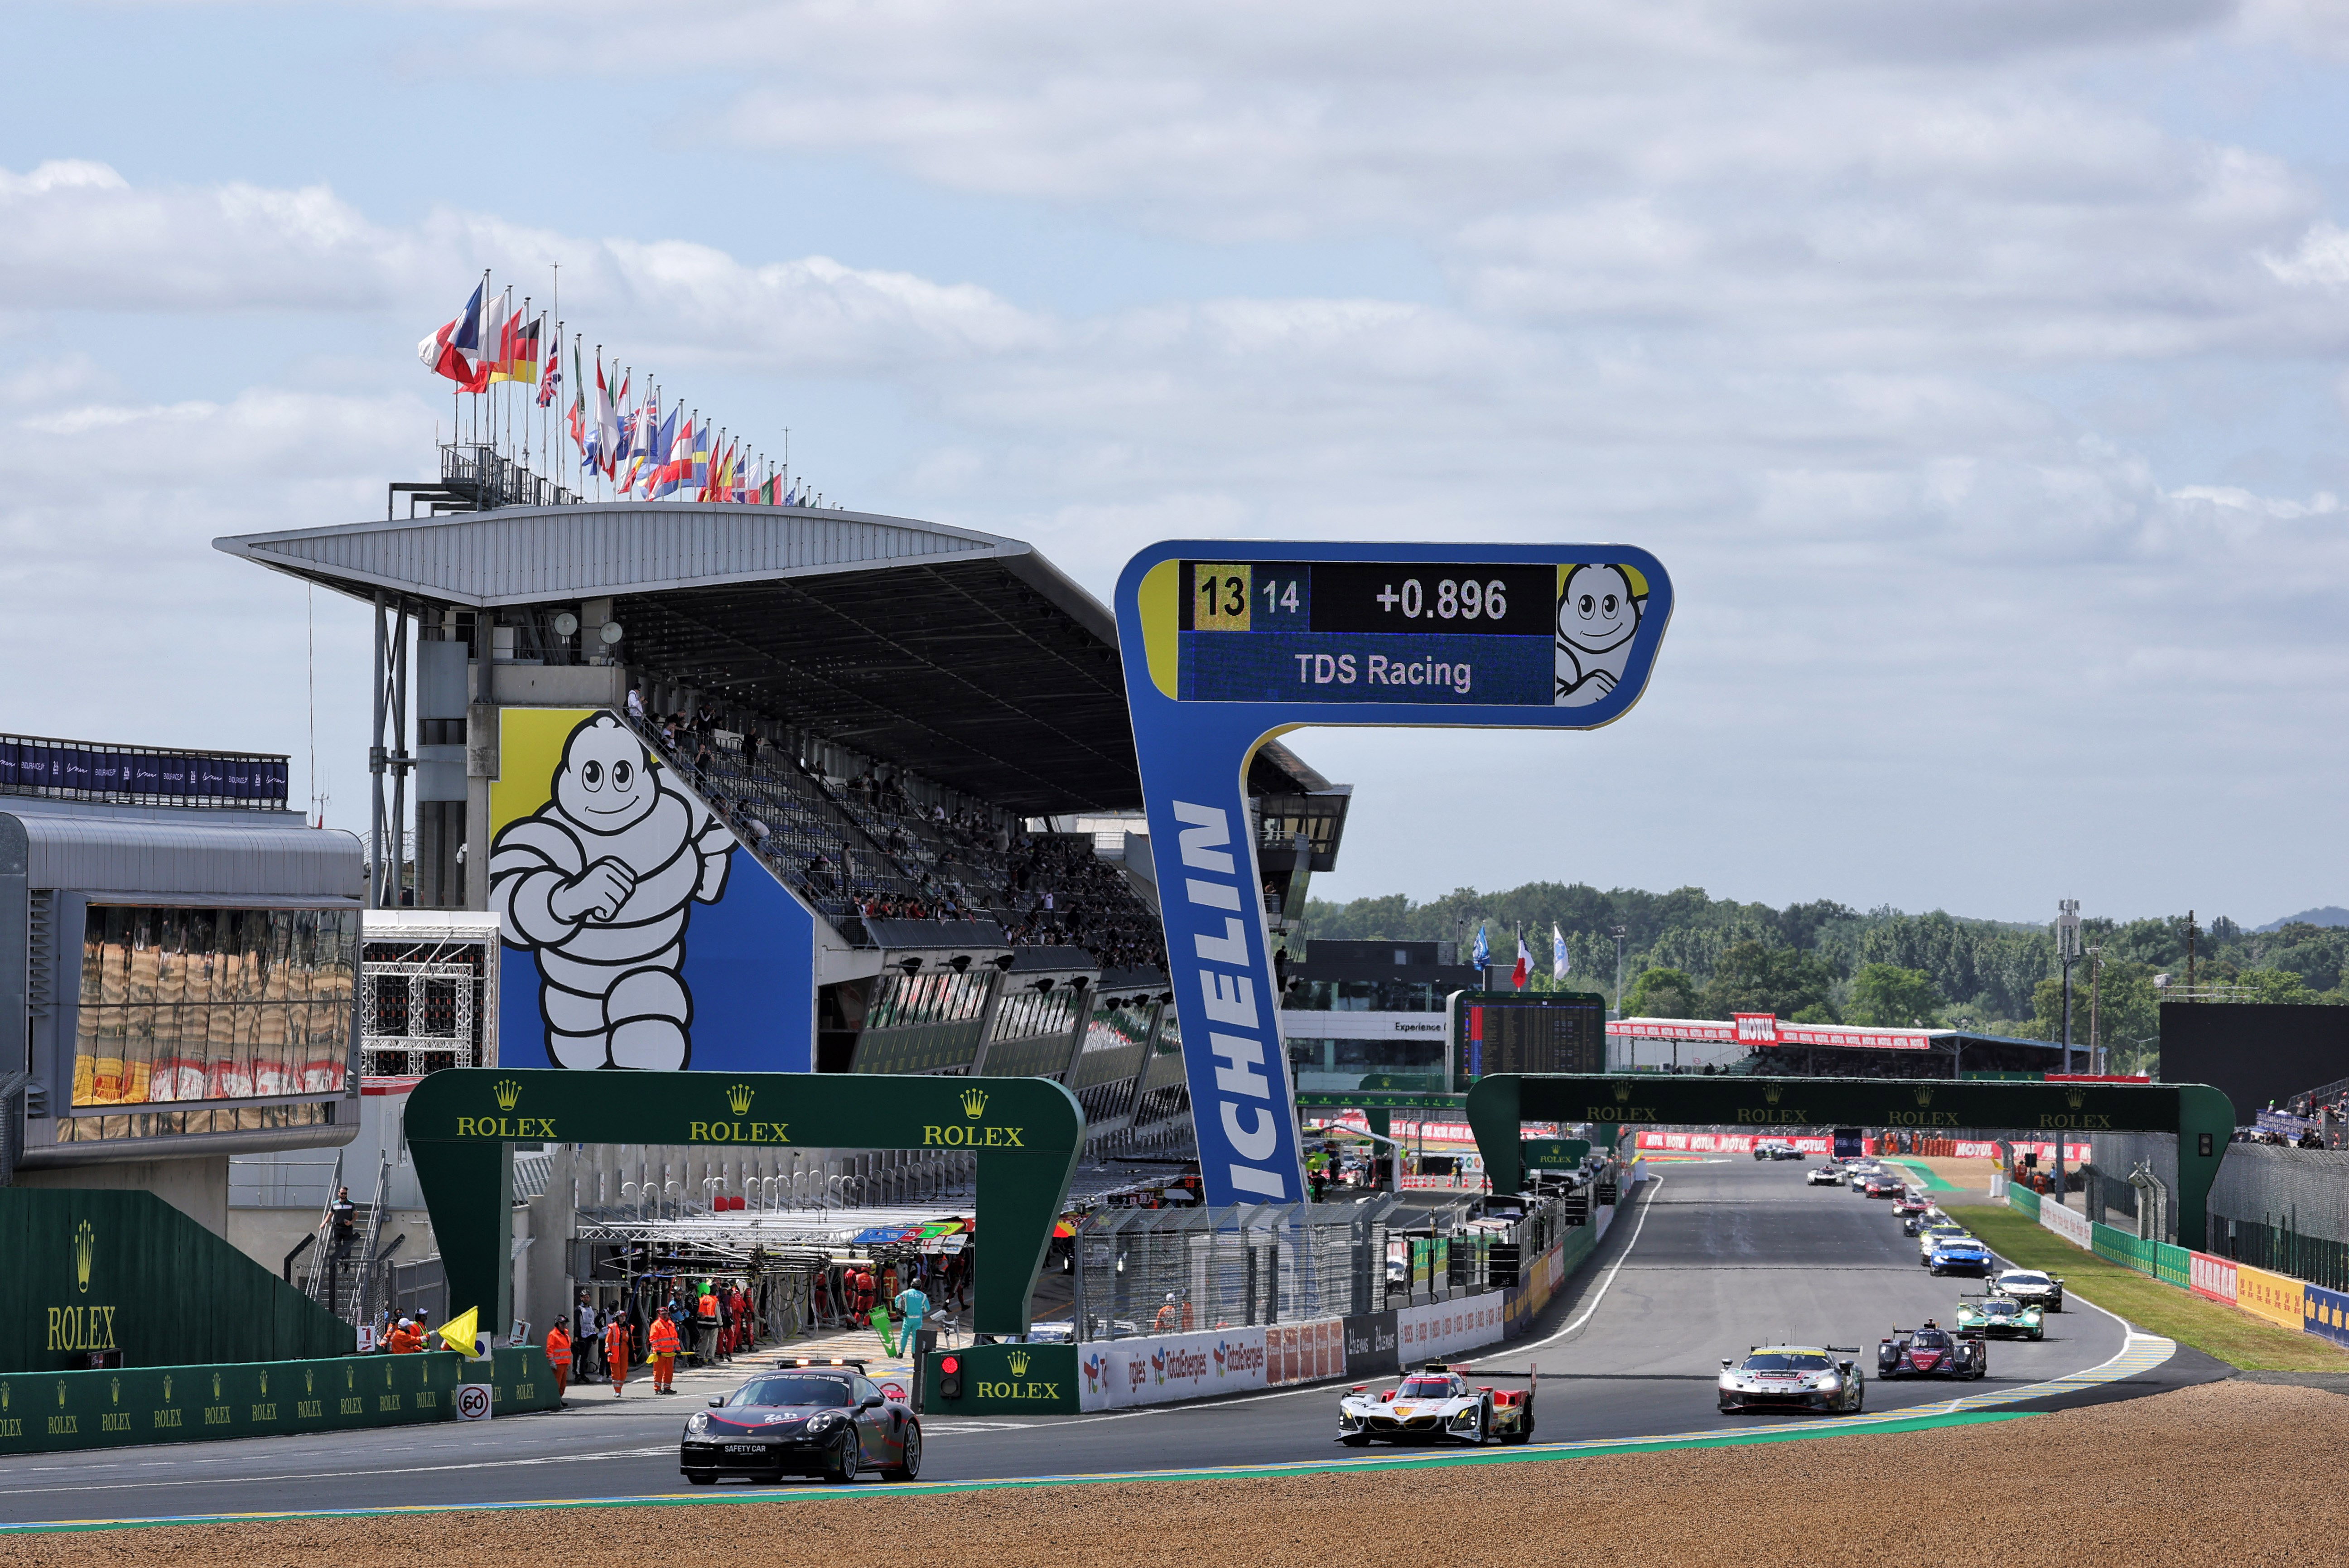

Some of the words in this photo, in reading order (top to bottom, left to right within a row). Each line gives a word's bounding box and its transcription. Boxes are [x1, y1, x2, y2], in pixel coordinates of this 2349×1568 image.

[1201, 576, 1245, 617] 13
[1262, 580, 1300, 613] 14
[1376, 579, 1507, 620] +0.896
[1294, 653, 1356, 684] TDS
[1368, 654, 1472, 694] Racing
[1395, 1022, 1441, 1032] Experience
[1738, 1018, 1776, 1041] MOTUL
[1587, 1107, 1657, 1121] ROLEX
[1737, 1108, 1808, 1124] ROLEX
[1888, 1111, 1959, 1126] ROLEX
[2040, 1114, 2111, 1129] ROLEX
[457, 1117, 557, 1138] ROLEX
[690, 1121, 790, 1142] ROLEX
[922, 1125, 1025, 1148] ROLEX
[1665, 1135, 1686, 1148] MOTUL
[1690, 1136, 1716, 1150] MOTUL
[1722, 1137, 1750, 1151] MOTUL
[1795, 1139, 1827, 1152] MOTUL
[1955, 1143, 1993, 1157] MOTUL
[923, 1240, 931, 1250] 4
[47, 1305, 116, 1351] ROLEX
[1166, 1346, 1207, 1385] TotalEnergies
[1226, 1339, 1264, 1377] TotalEnergies
[749, 1375, 844, 1383] PORSCHE
[492, 1386, 502, 1402] LEX
[516, 1384, 534, 1400] ROLEX
[977, 1382, 1060, 1399] ROLEX
[340, 1397, 362, 1414] ROLEX
[380, 1394, 400, 1412] ROLEX
[416, 1391, 436, 1408] ROLEX
[463, 1395, 483, 1410] 60
[205, 1406, 231, 1425] ROLEX
[252, 1403, 277, 1421] ROLEX
[298, 1400, 322, 1418] ROLEX
[48, 1415, 78, 1434] ROLEX
[102, 1413, 131, 1431] ROLEX
[154, 1409, 182, 1428] ROLEX
[0, 1418, 22, 1437] OLEX
